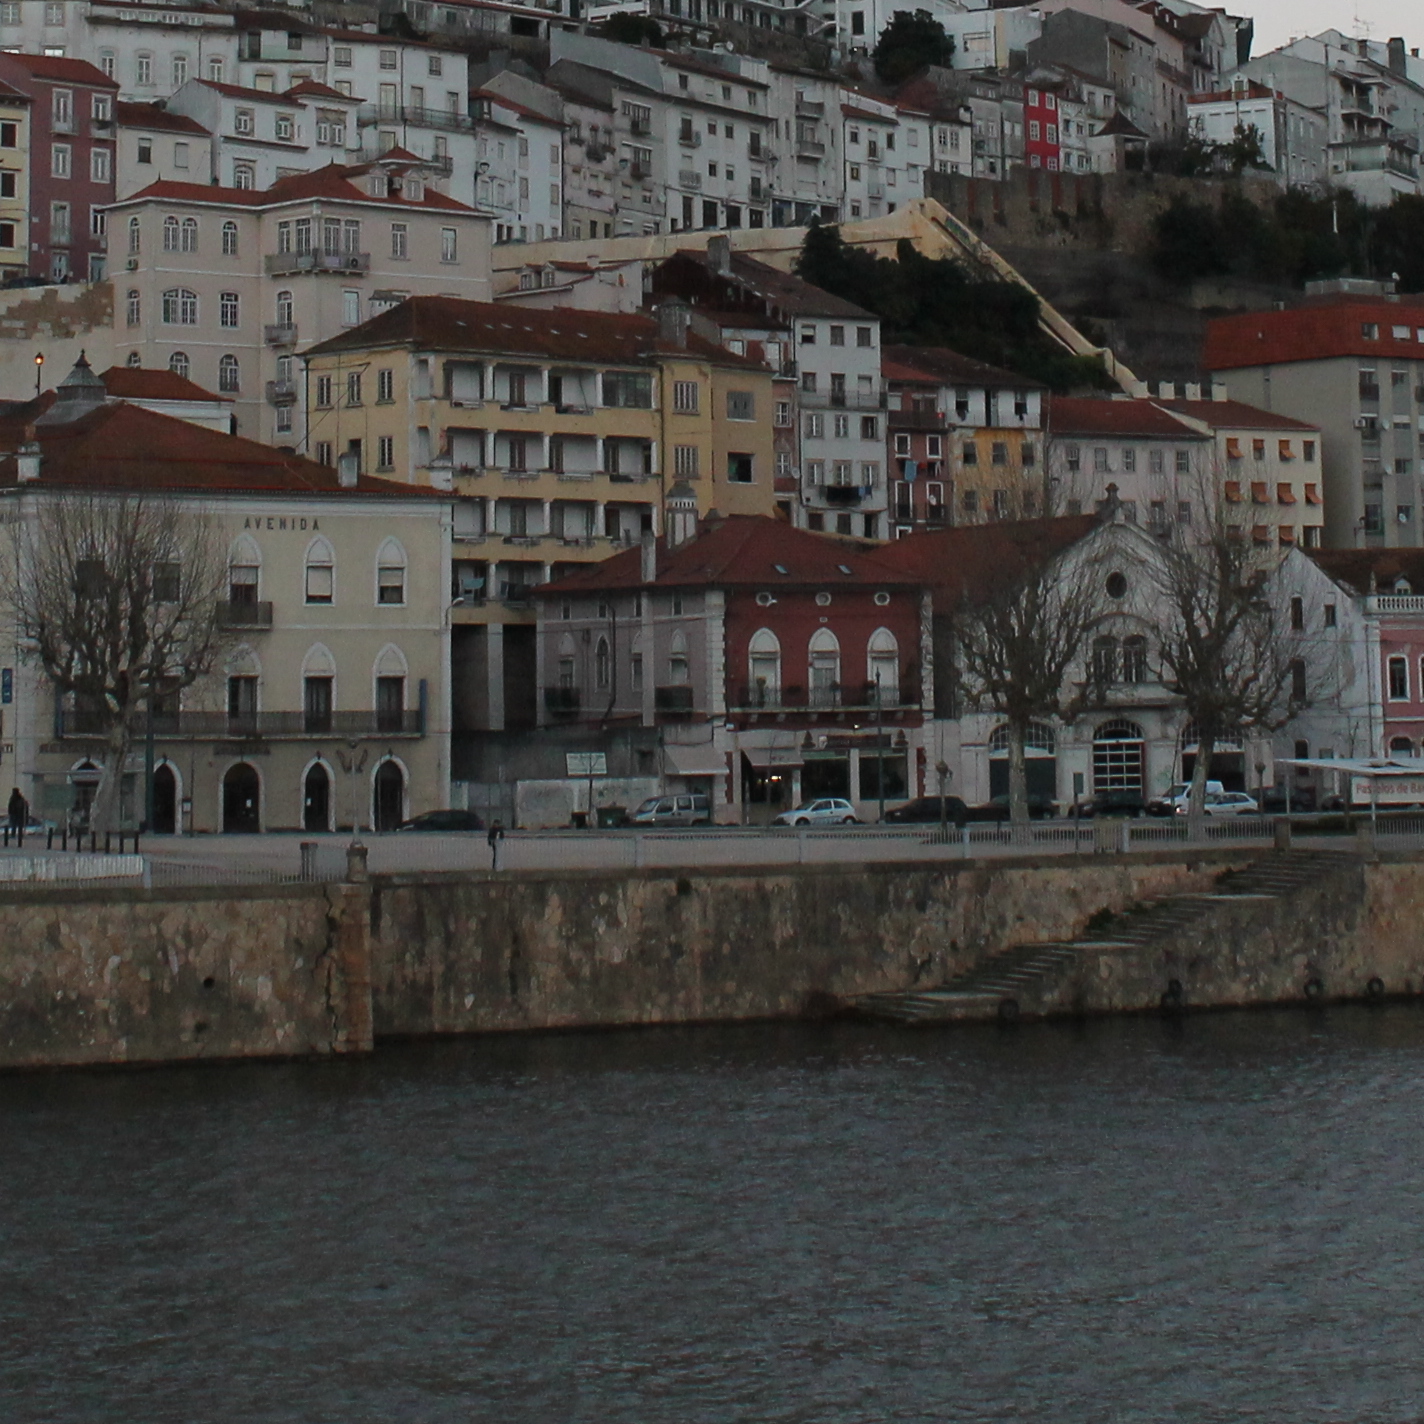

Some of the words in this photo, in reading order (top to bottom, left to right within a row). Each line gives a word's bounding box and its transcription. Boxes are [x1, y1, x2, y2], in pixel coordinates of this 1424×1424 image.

[244, 518, 319, 530] AVENIDA
[1356, 782, 1396, 794] Paseios
[1397, 783, 1408, 794] de
